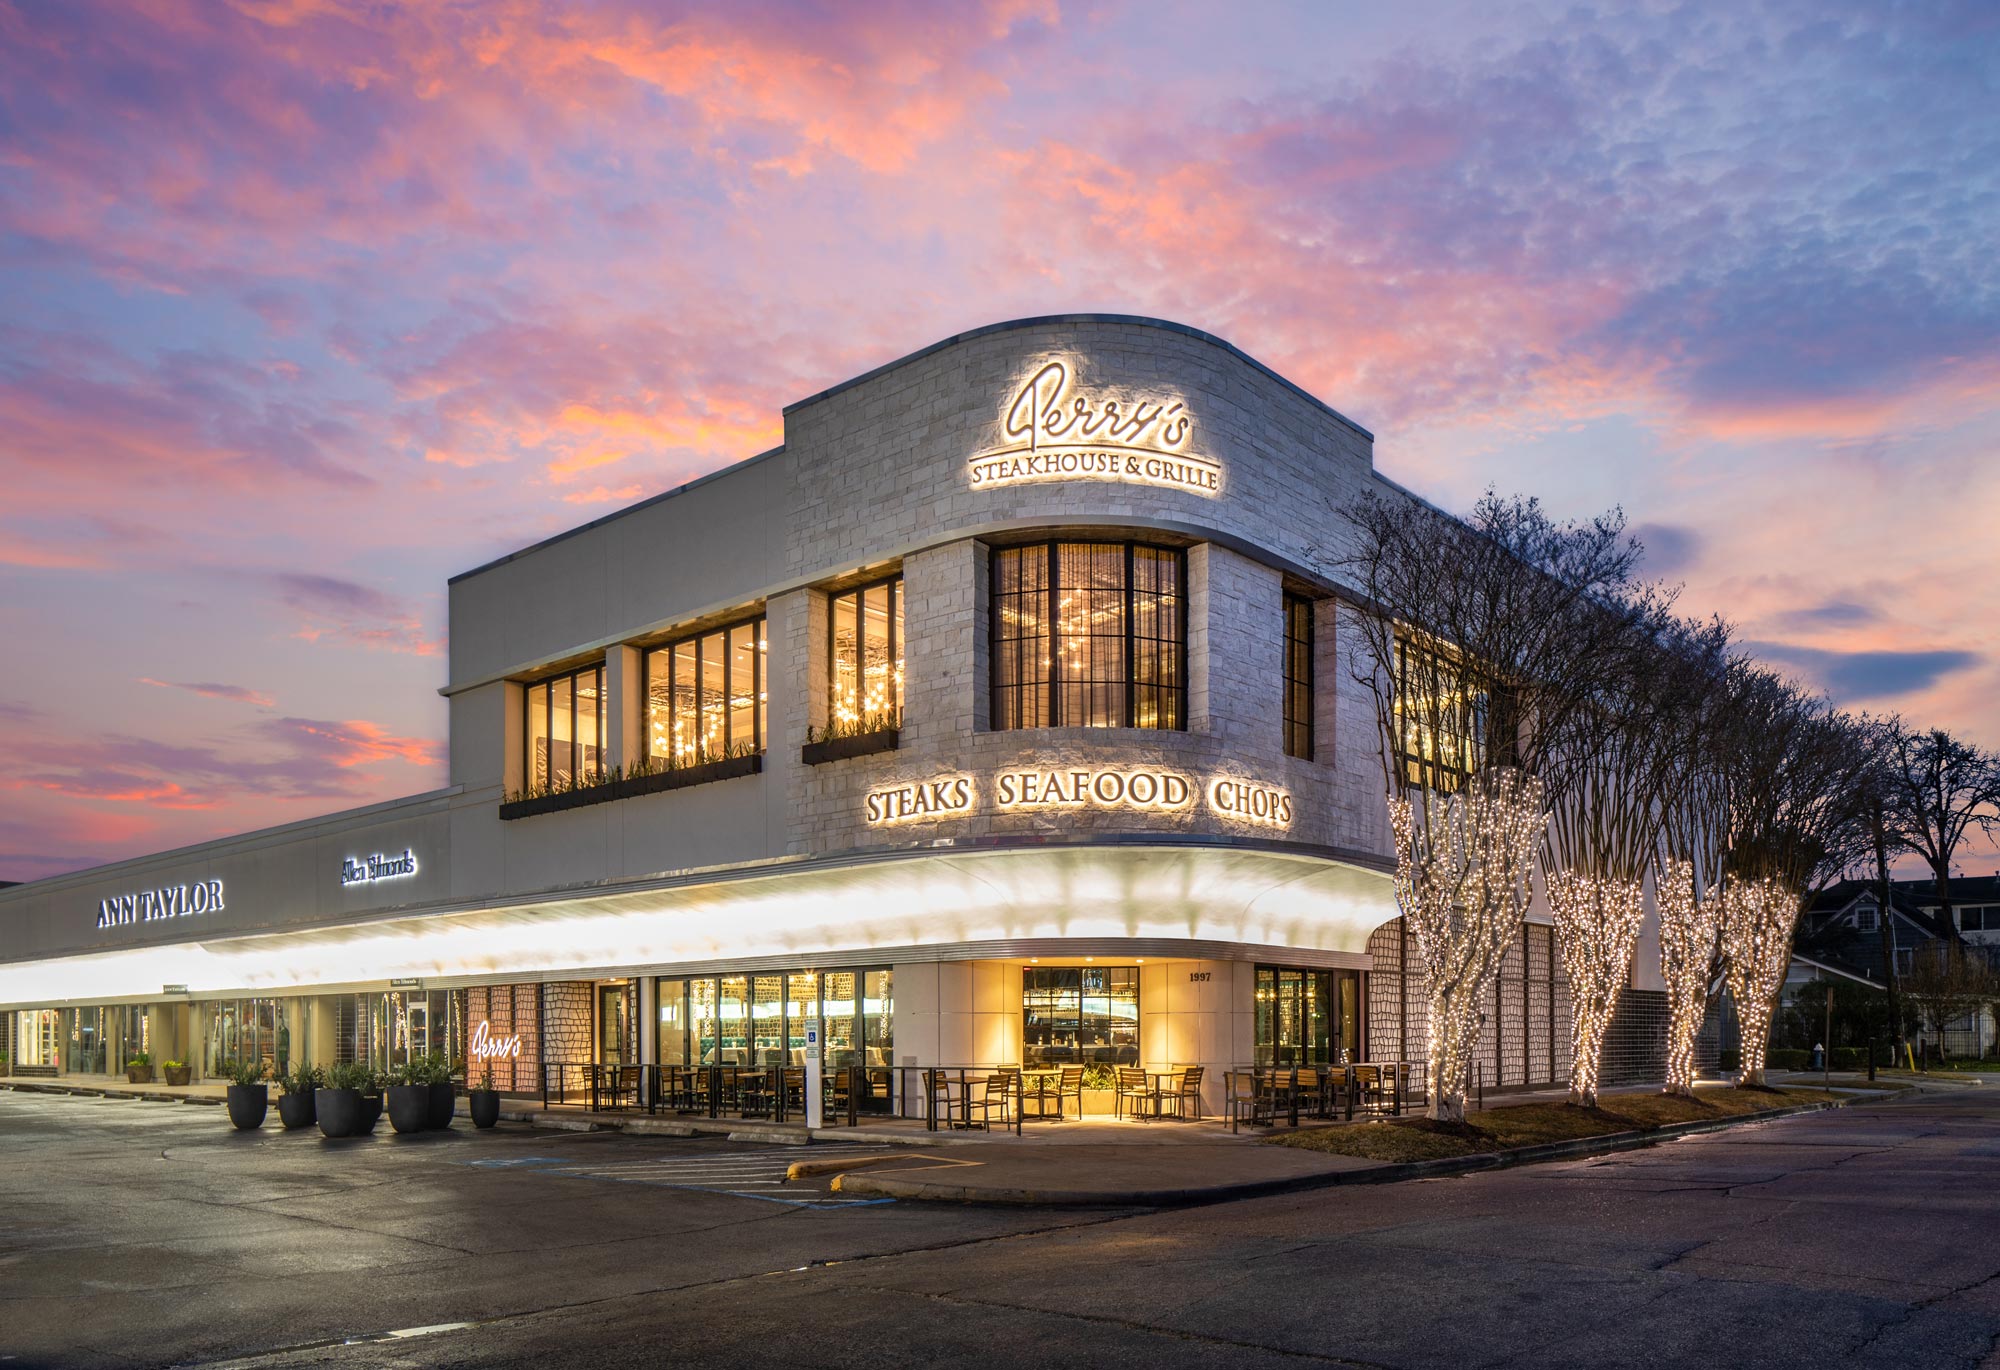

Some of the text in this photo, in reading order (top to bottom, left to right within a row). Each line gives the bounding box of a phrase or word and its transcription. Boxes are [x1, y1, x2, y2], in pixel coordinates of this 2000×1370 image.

[1006, 362, 1189, 452] Perry's
[972, 453, 1218, 490] STEAKHOUSE & GRILLE
[867, 772, 1292, 822] STEAKS SEAFOOD CHOPS
[341, 850, 416, 884] Allen Edmonds
[96, 880, 225, 928] ANN TAYLOR
[1190, 972, 1211, 982] 1997
[472, 1020, 522, 1063] Perry's
